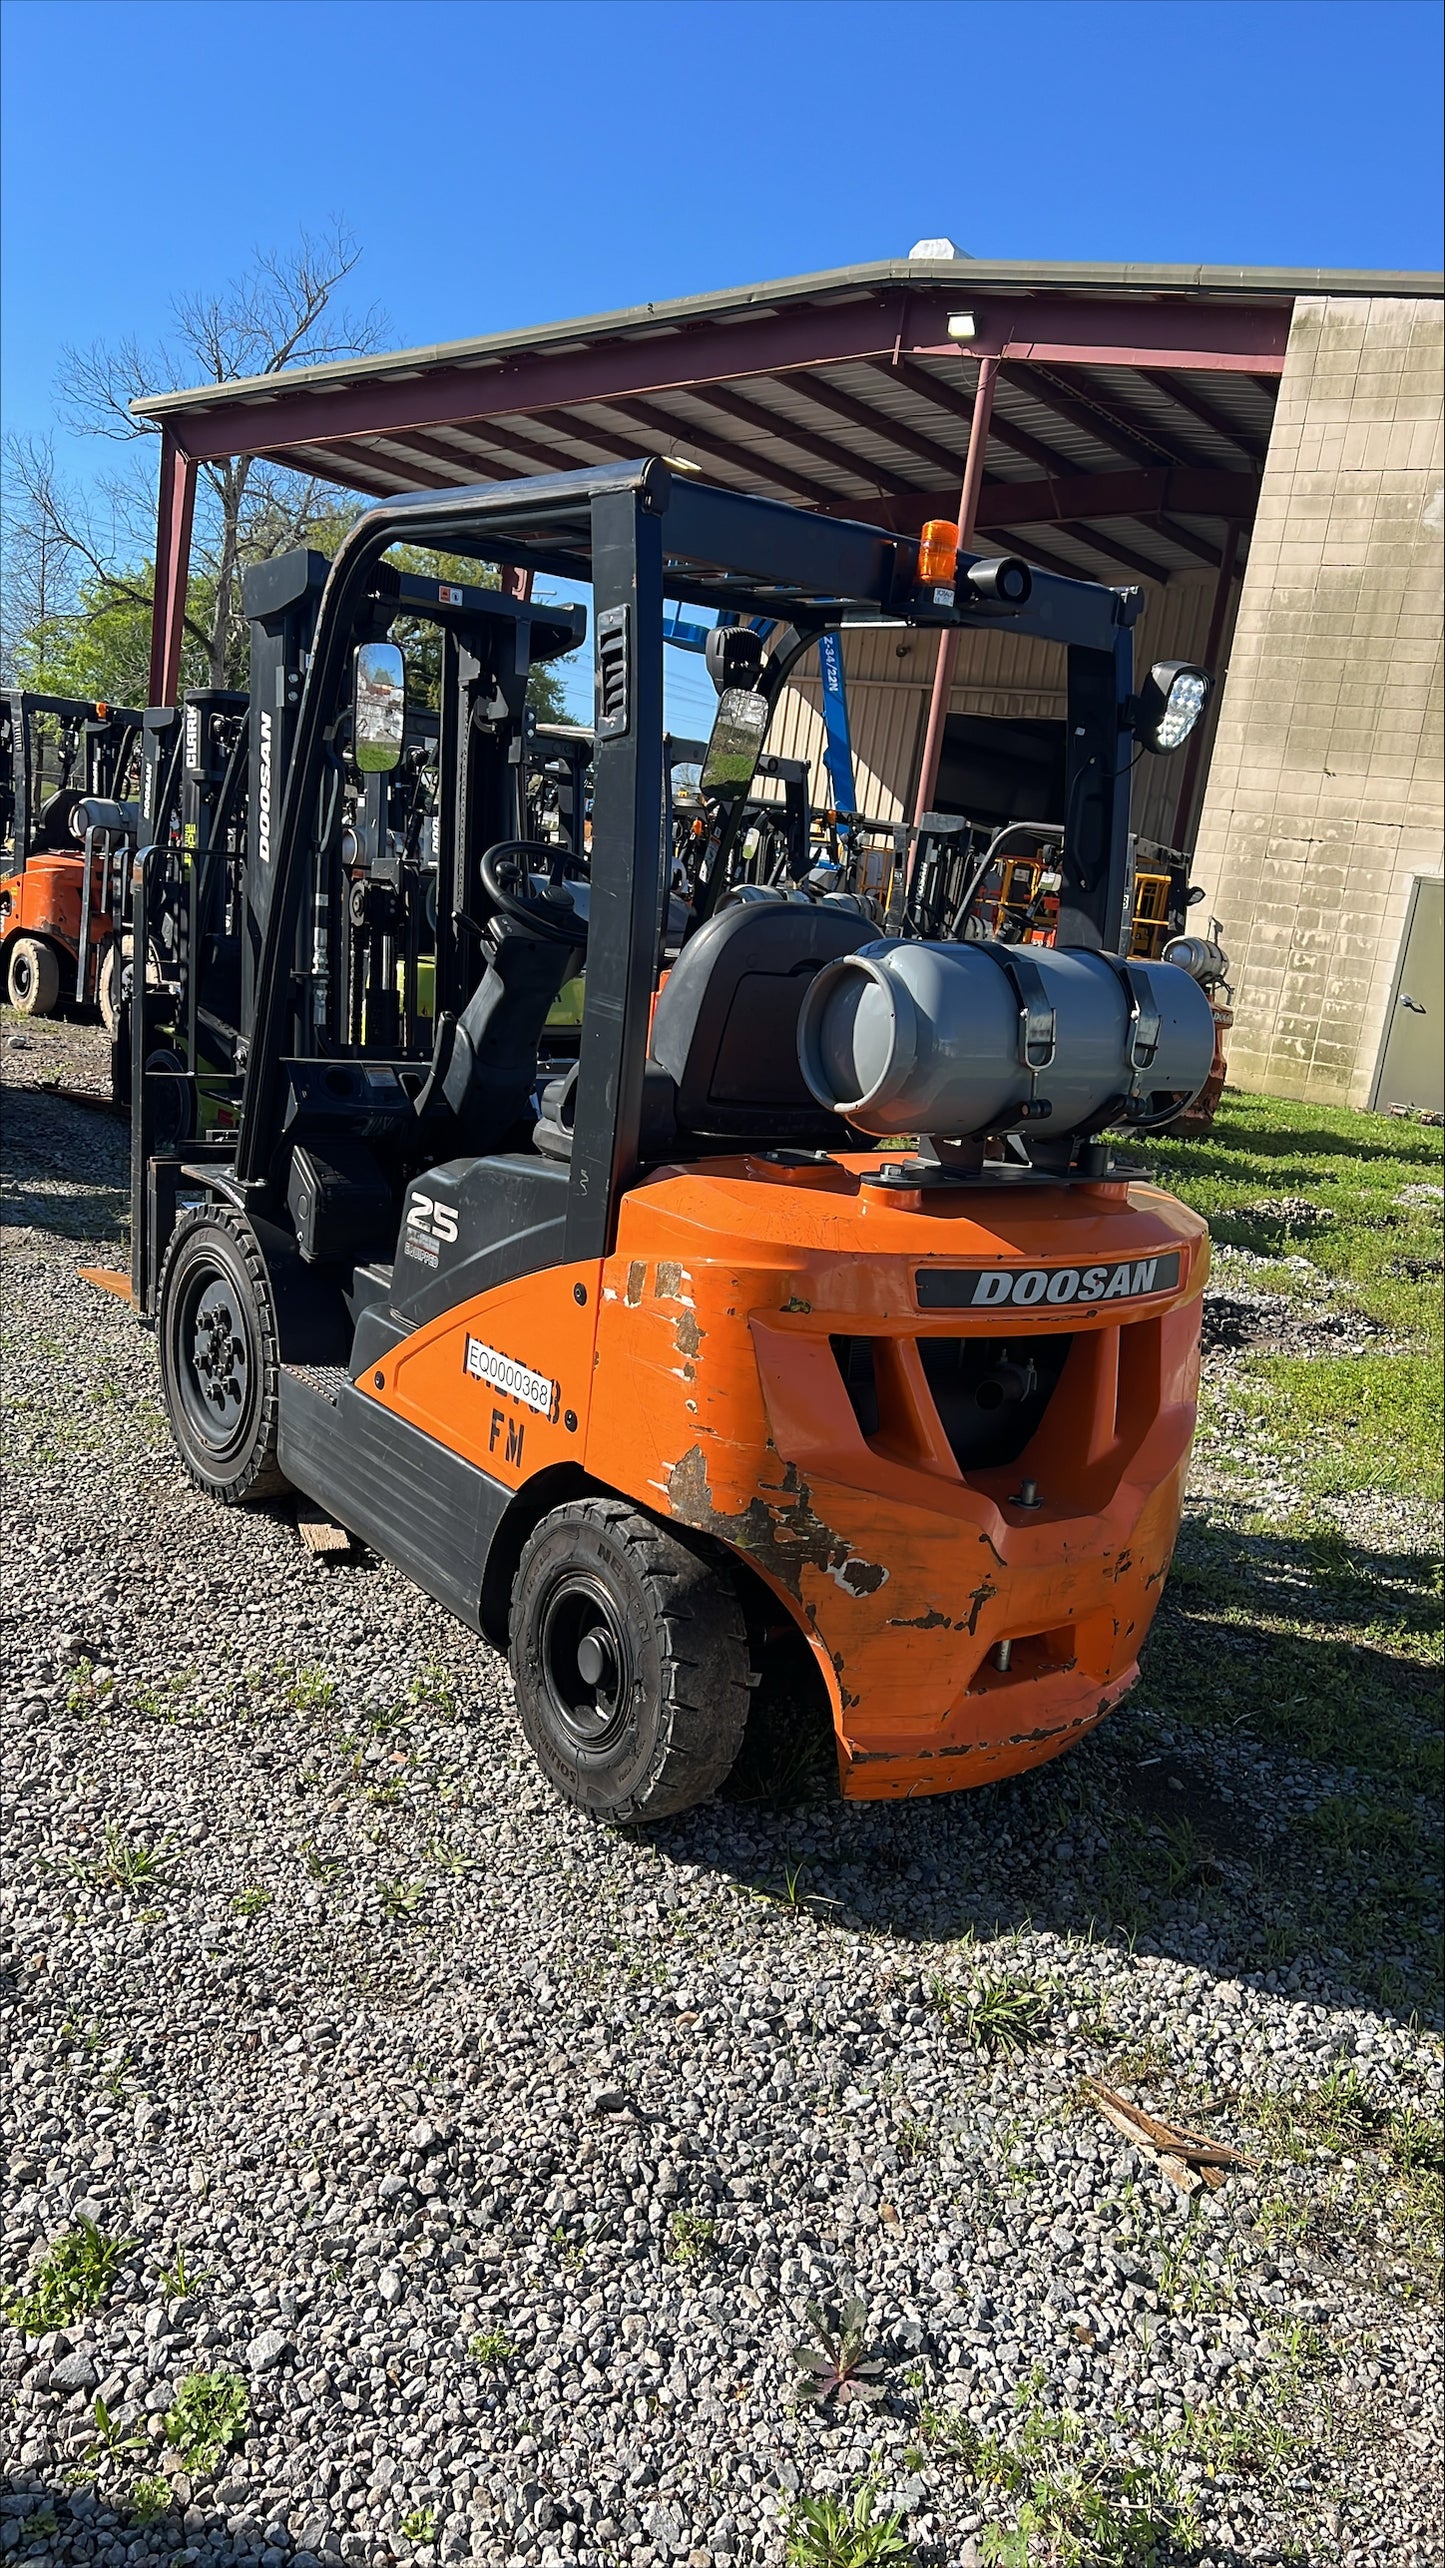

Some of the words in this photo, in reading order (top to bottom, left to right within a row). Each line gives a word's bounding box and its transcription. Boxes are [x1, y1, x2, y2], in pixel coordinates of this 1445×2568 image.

[823, 635, 839, 692] Z-34/22N
[186, 705, 197, 768] CLARK
[143, 763, 152, 820] DOOSAN
[259, 711, 272, 863] DOOSAN
[407, 1191, 459, 1243] 25
[971, 1259, 1158, 1305] DOOSAN
[469, 1345, 548, 1406] EQ0000368
[489, 1408, 525, 1468] FM
